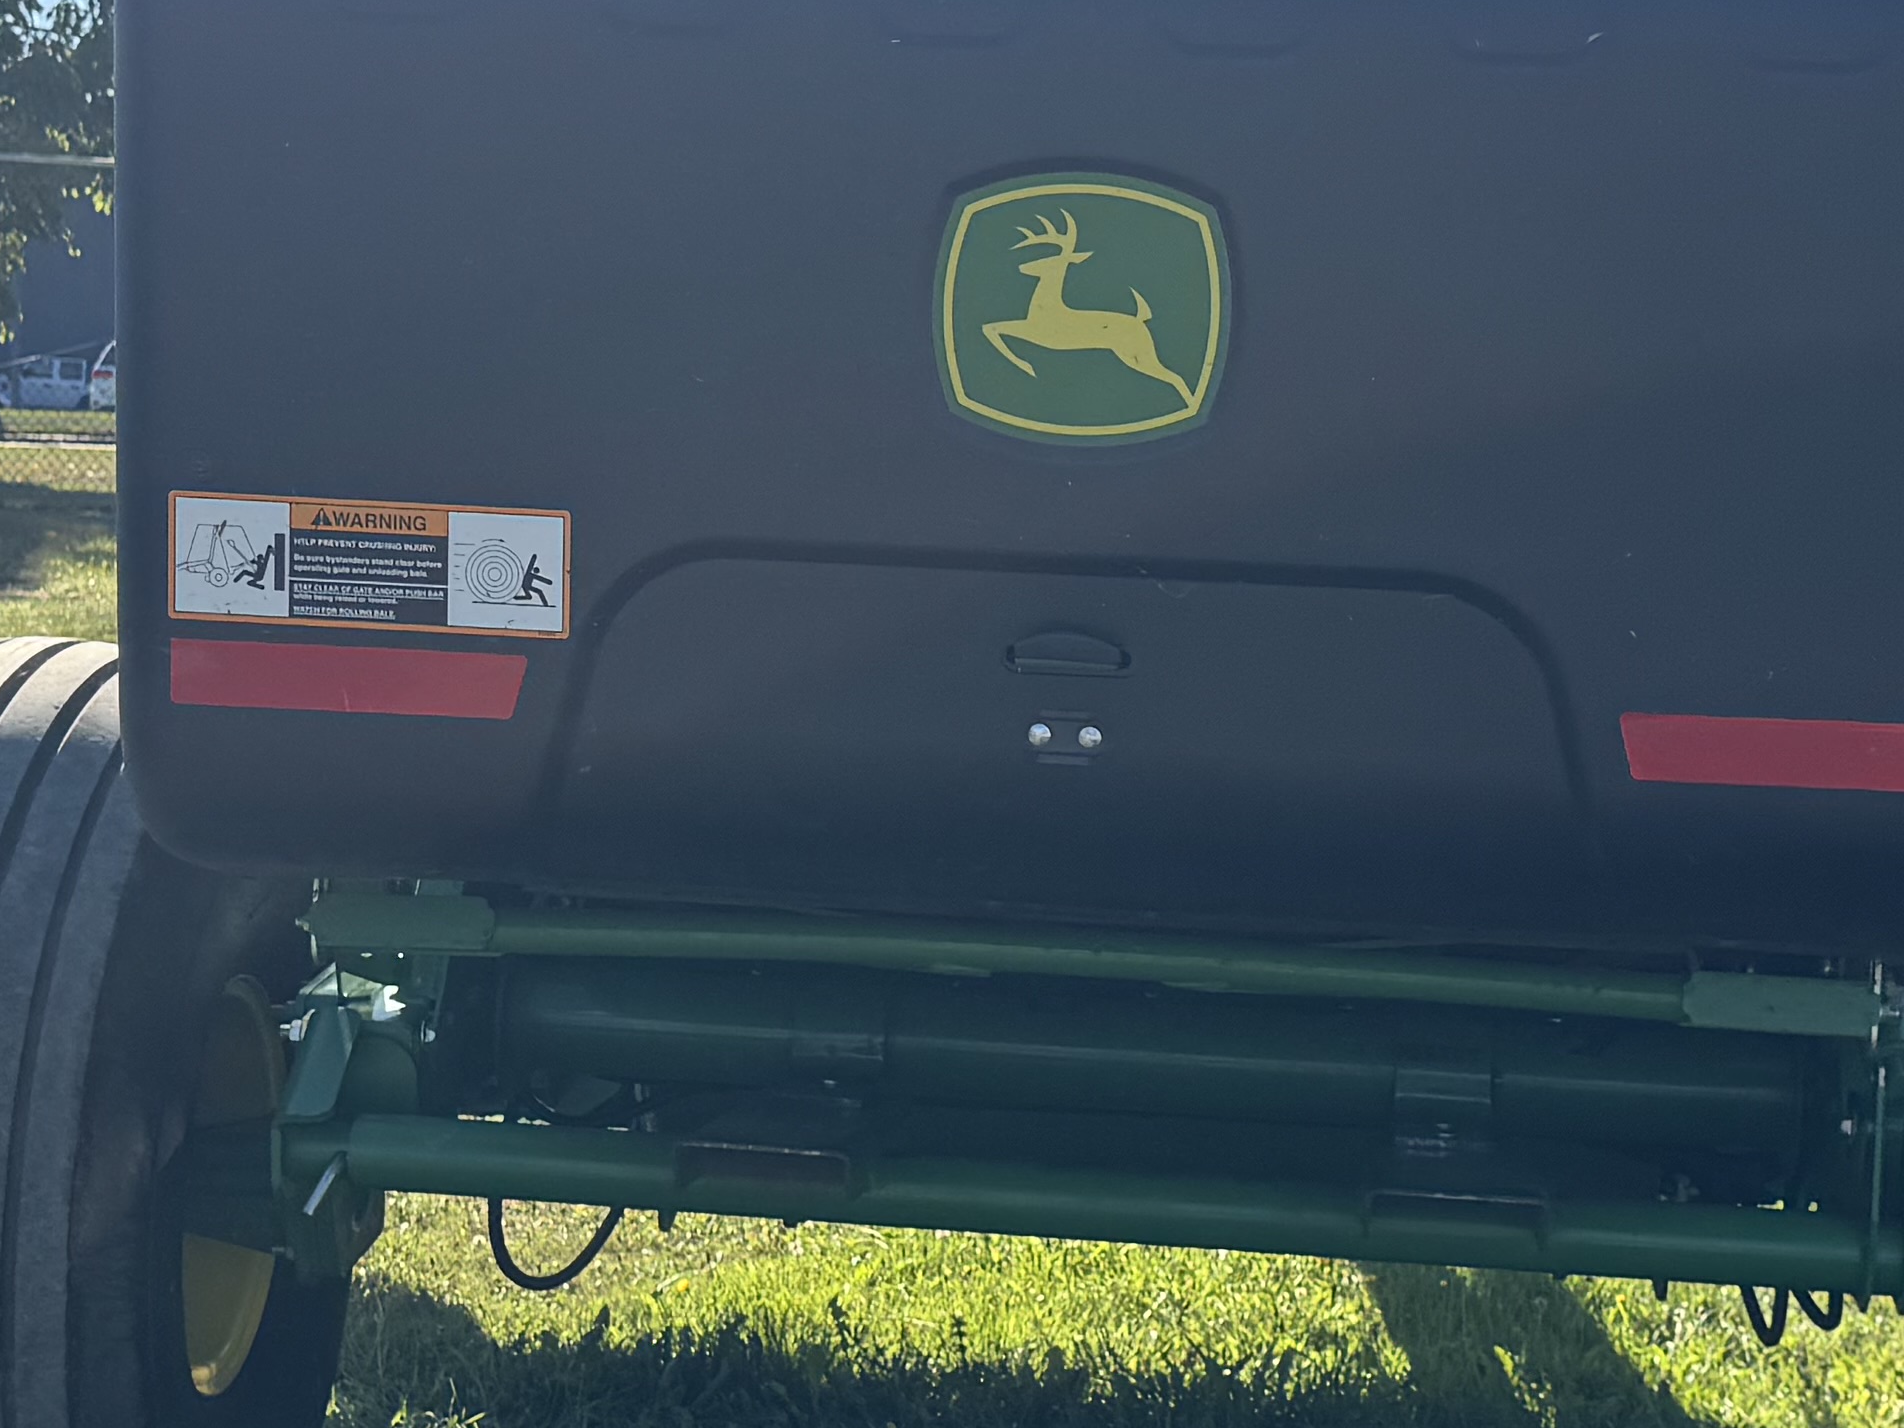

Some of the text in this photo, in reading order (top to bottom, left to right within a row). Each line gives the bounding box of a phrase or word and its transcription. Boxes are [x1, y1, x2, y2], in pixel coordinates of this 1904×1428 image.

[332, 510, 427, 532] WARNING
[318, 538, 356, 548] PREVENT
[326, 555, 370, 565] bystanders
